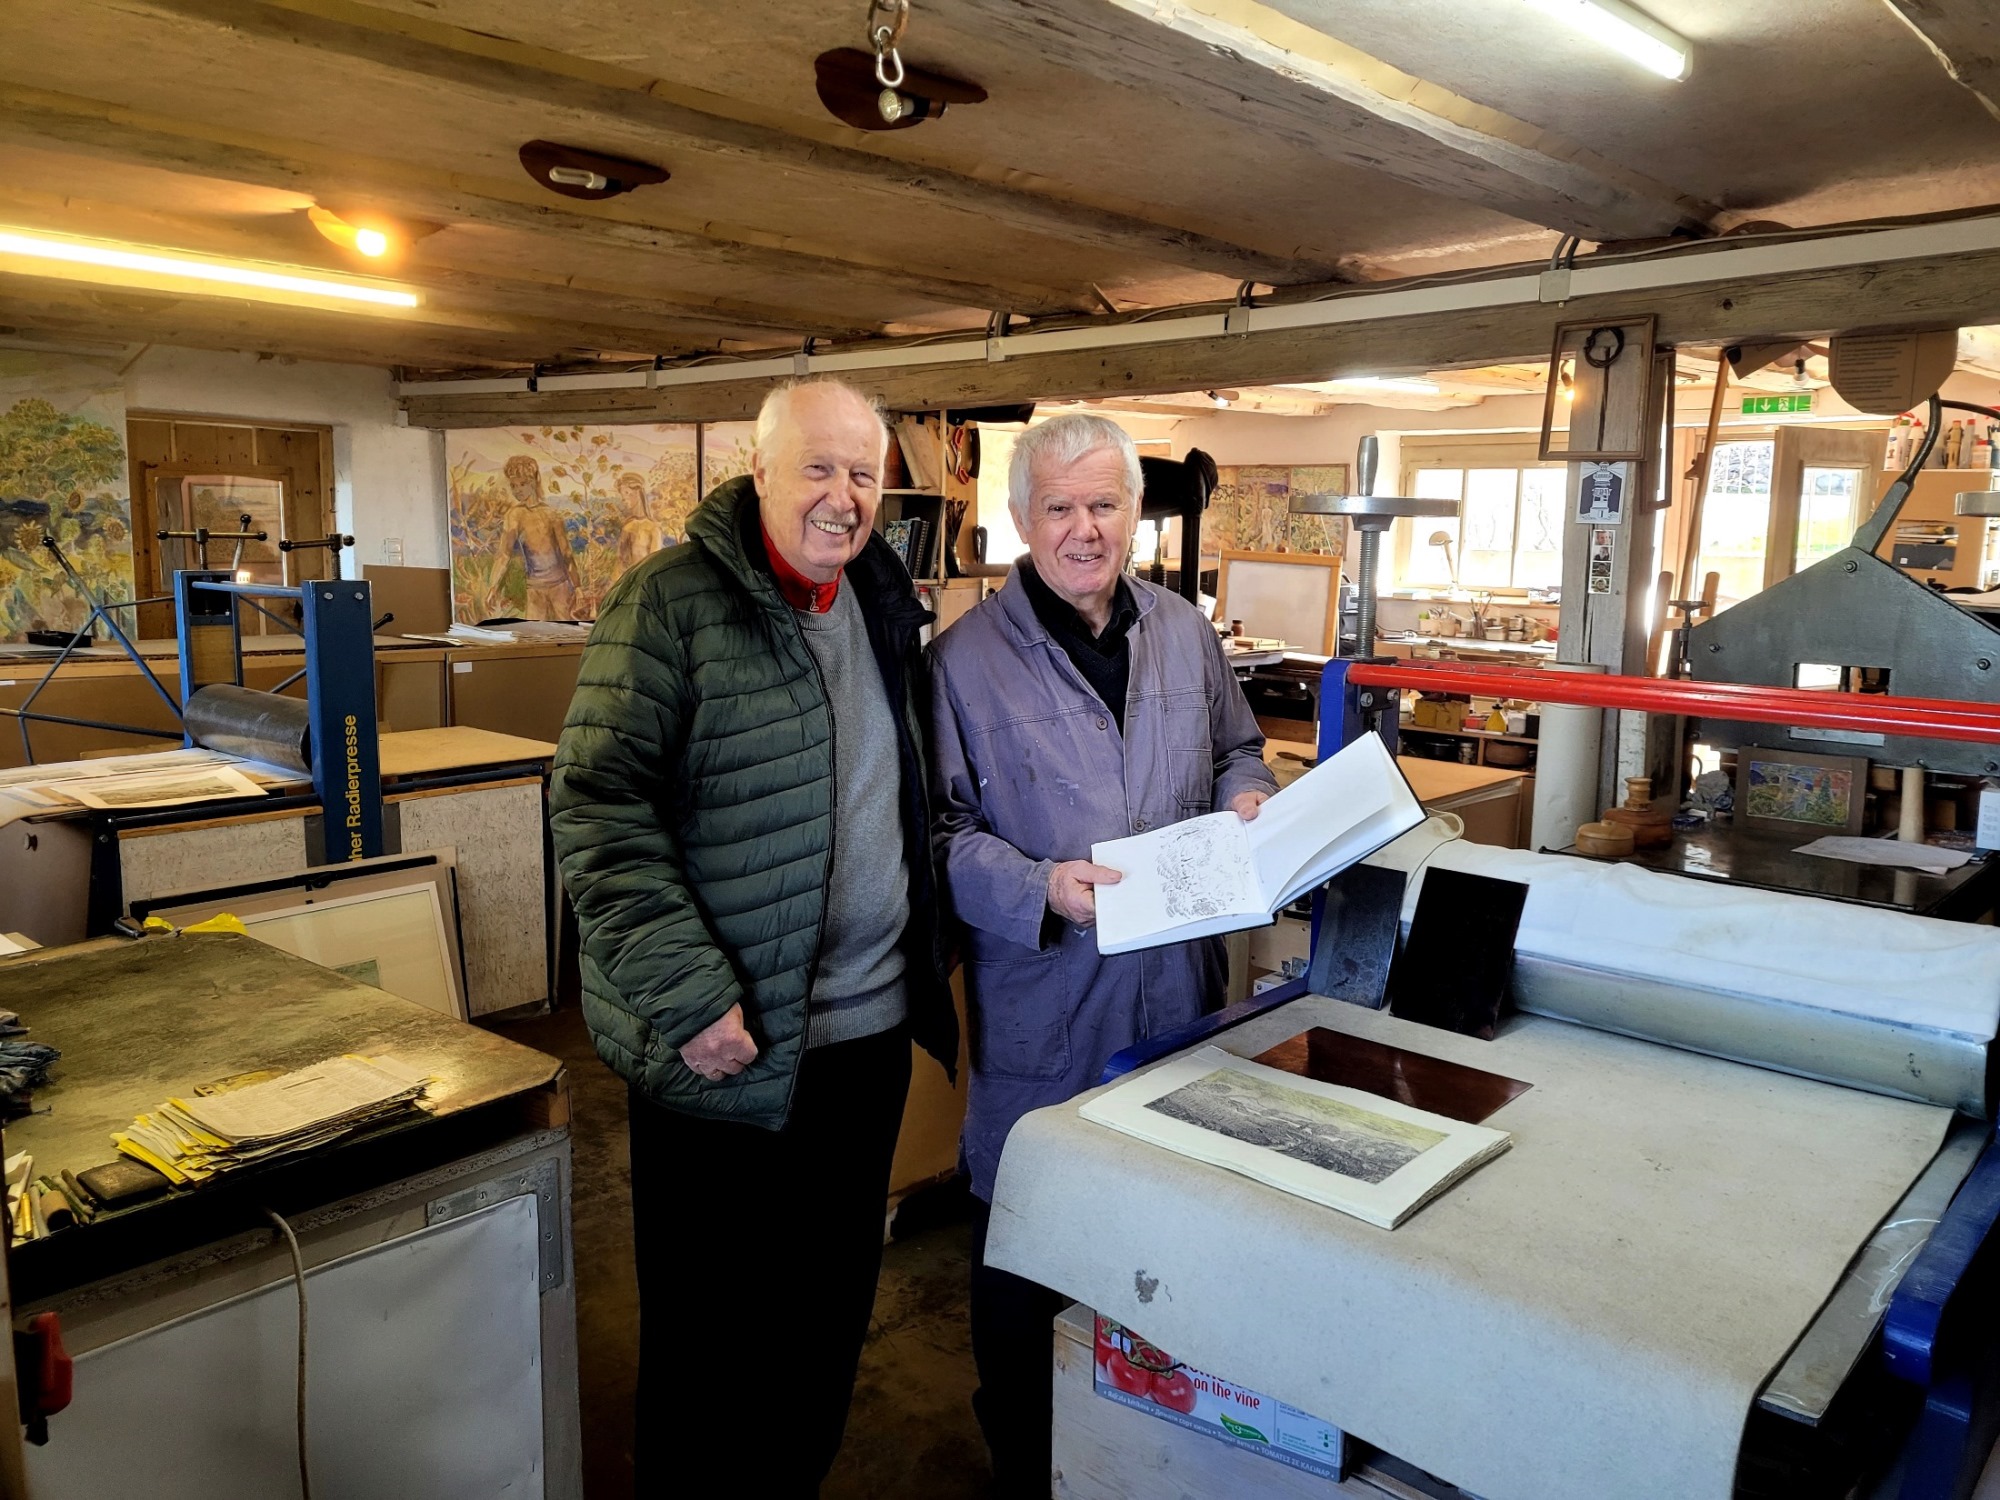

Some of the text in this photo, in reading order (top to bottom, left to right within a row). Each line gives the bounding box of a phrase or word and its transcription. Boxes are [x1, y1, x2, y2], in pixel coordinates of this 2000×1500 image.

[344, 714, 362, 828] Radierpresse
[1194, 1378, 1260, 1410] on the vine
